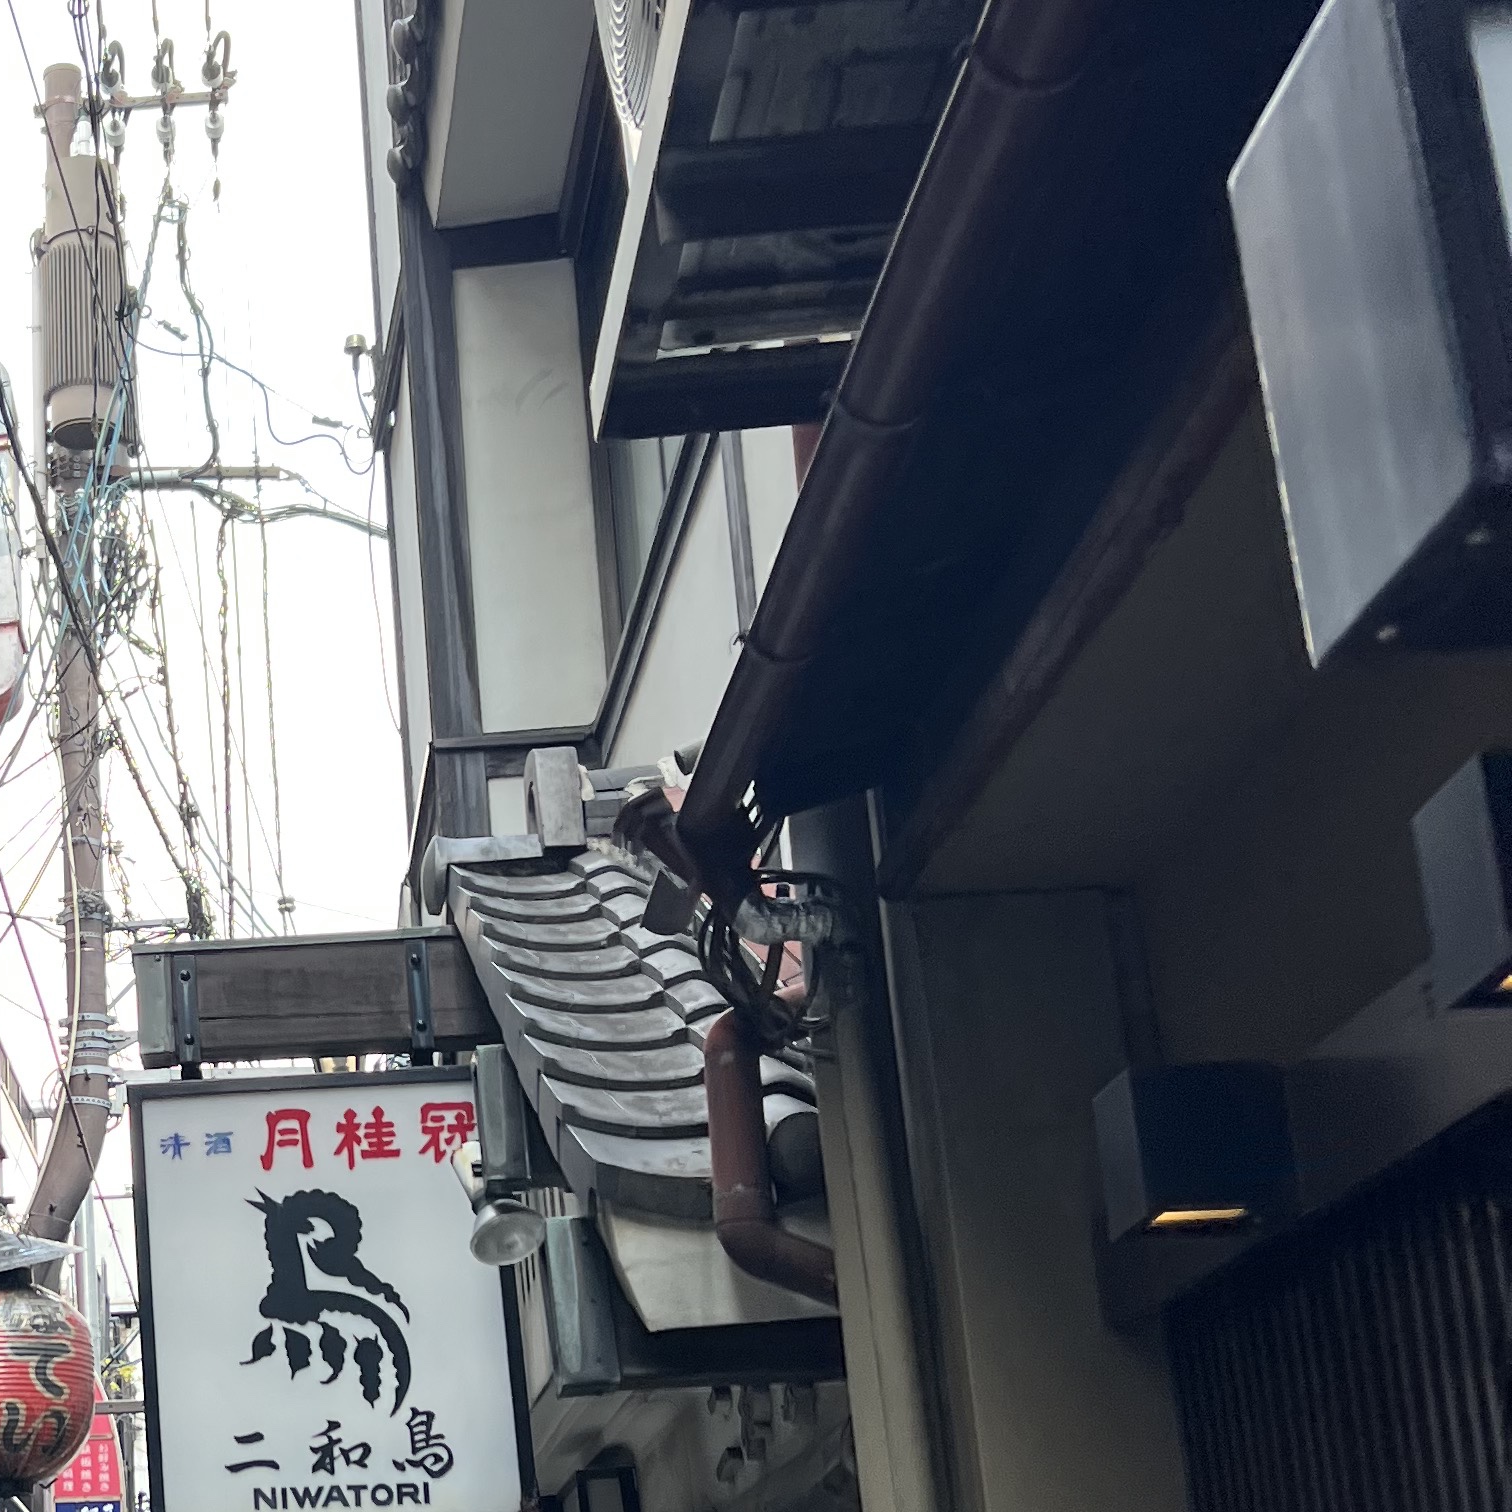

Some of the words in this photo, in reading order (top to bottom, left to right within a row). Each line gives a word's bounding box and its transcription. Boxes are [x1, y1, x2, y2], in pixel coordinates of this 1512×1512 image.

[159, 1130, 235, 1161] 清酒
[259, 1101, 477, 1171] 月桂冠
[224, 1407, 454, 1479] 二和鳥
[252, 1481, 431, 1511] NIWATORI
